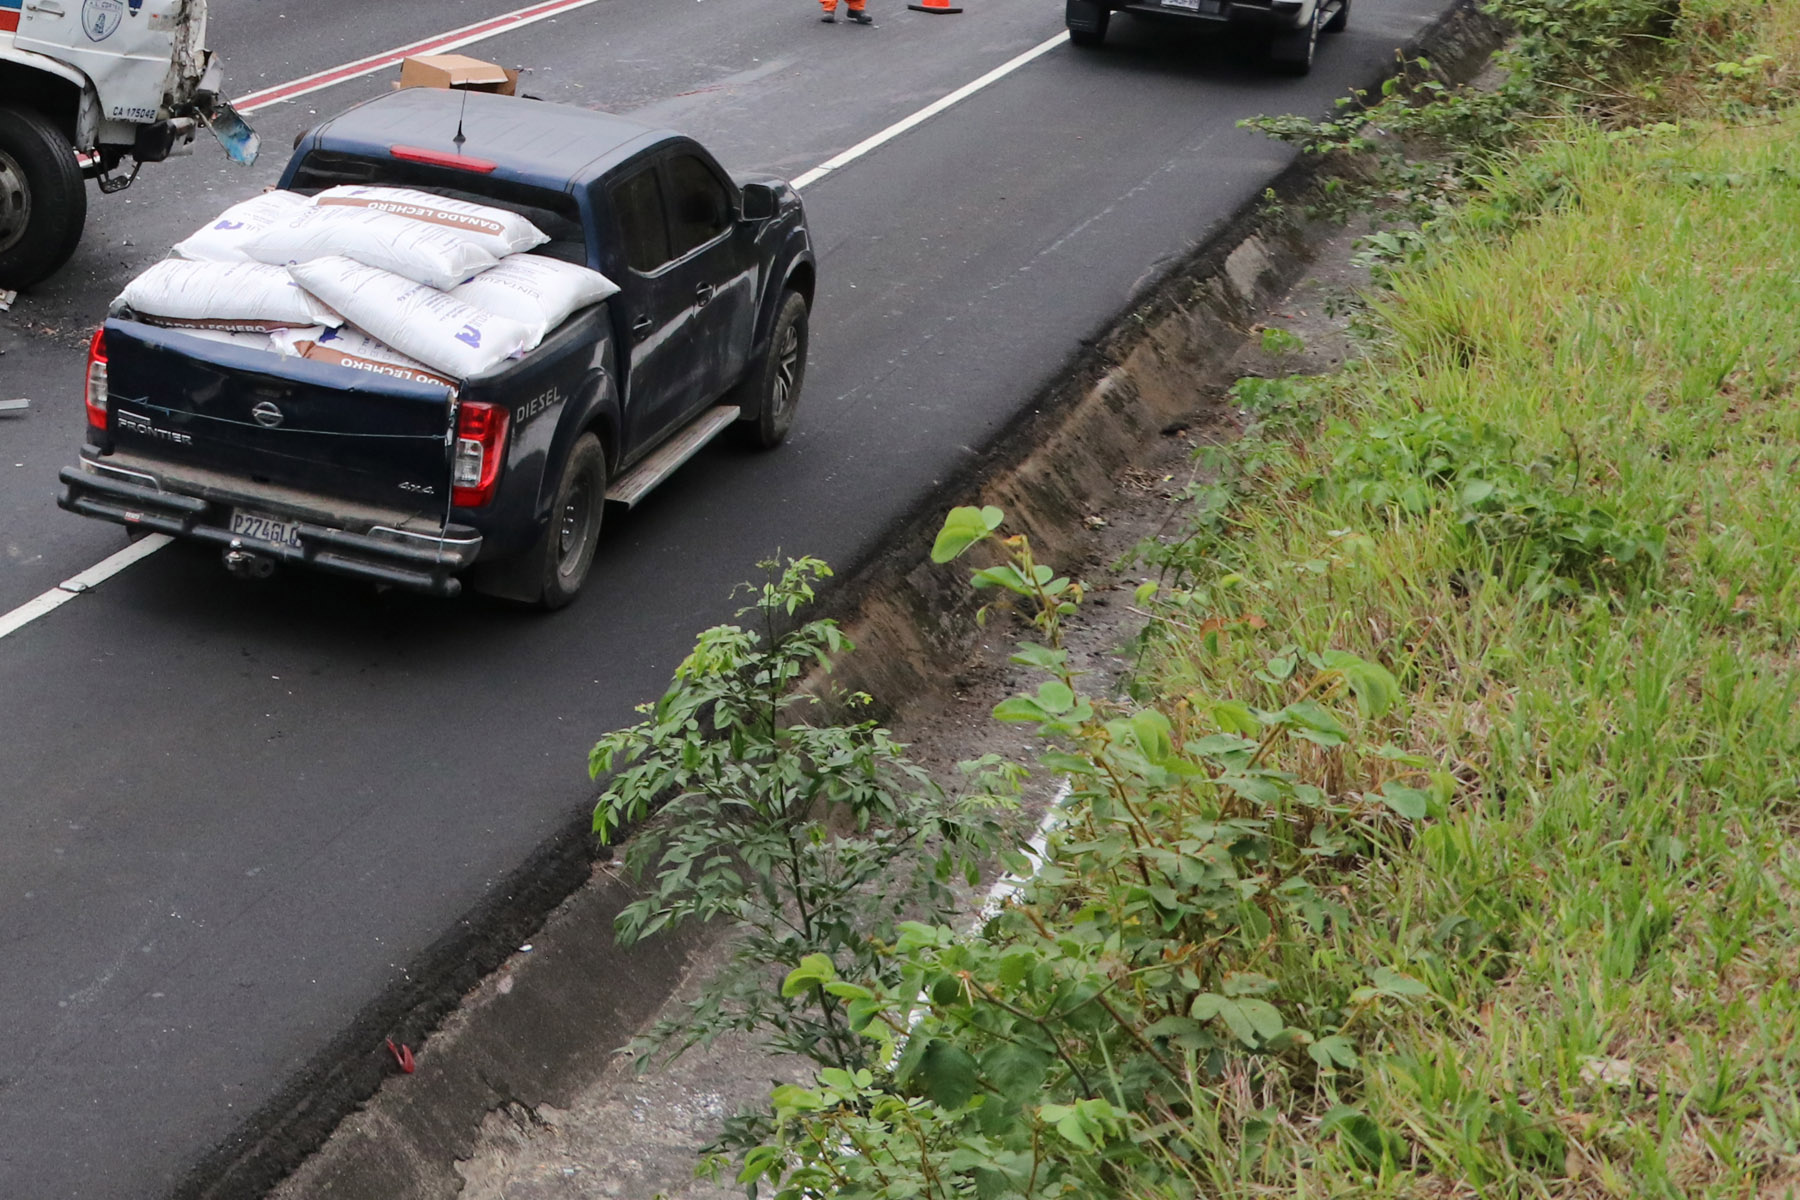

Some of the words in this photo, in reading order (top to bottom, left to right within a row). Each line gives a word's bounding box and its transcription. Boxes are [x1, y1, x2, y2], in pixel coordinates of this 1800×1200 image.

[112, 106, 123, 116] CA
[368, 201, 434, 223] LECHERO
[435, 210, 501, 232] GANADO
[207, 324, 266, 332] LECHERO
[340, 358, 412, 383] LECHERO
[516, 387, 561, 424] DIESEL
[118, 417, 193, 446] FRONTIER
